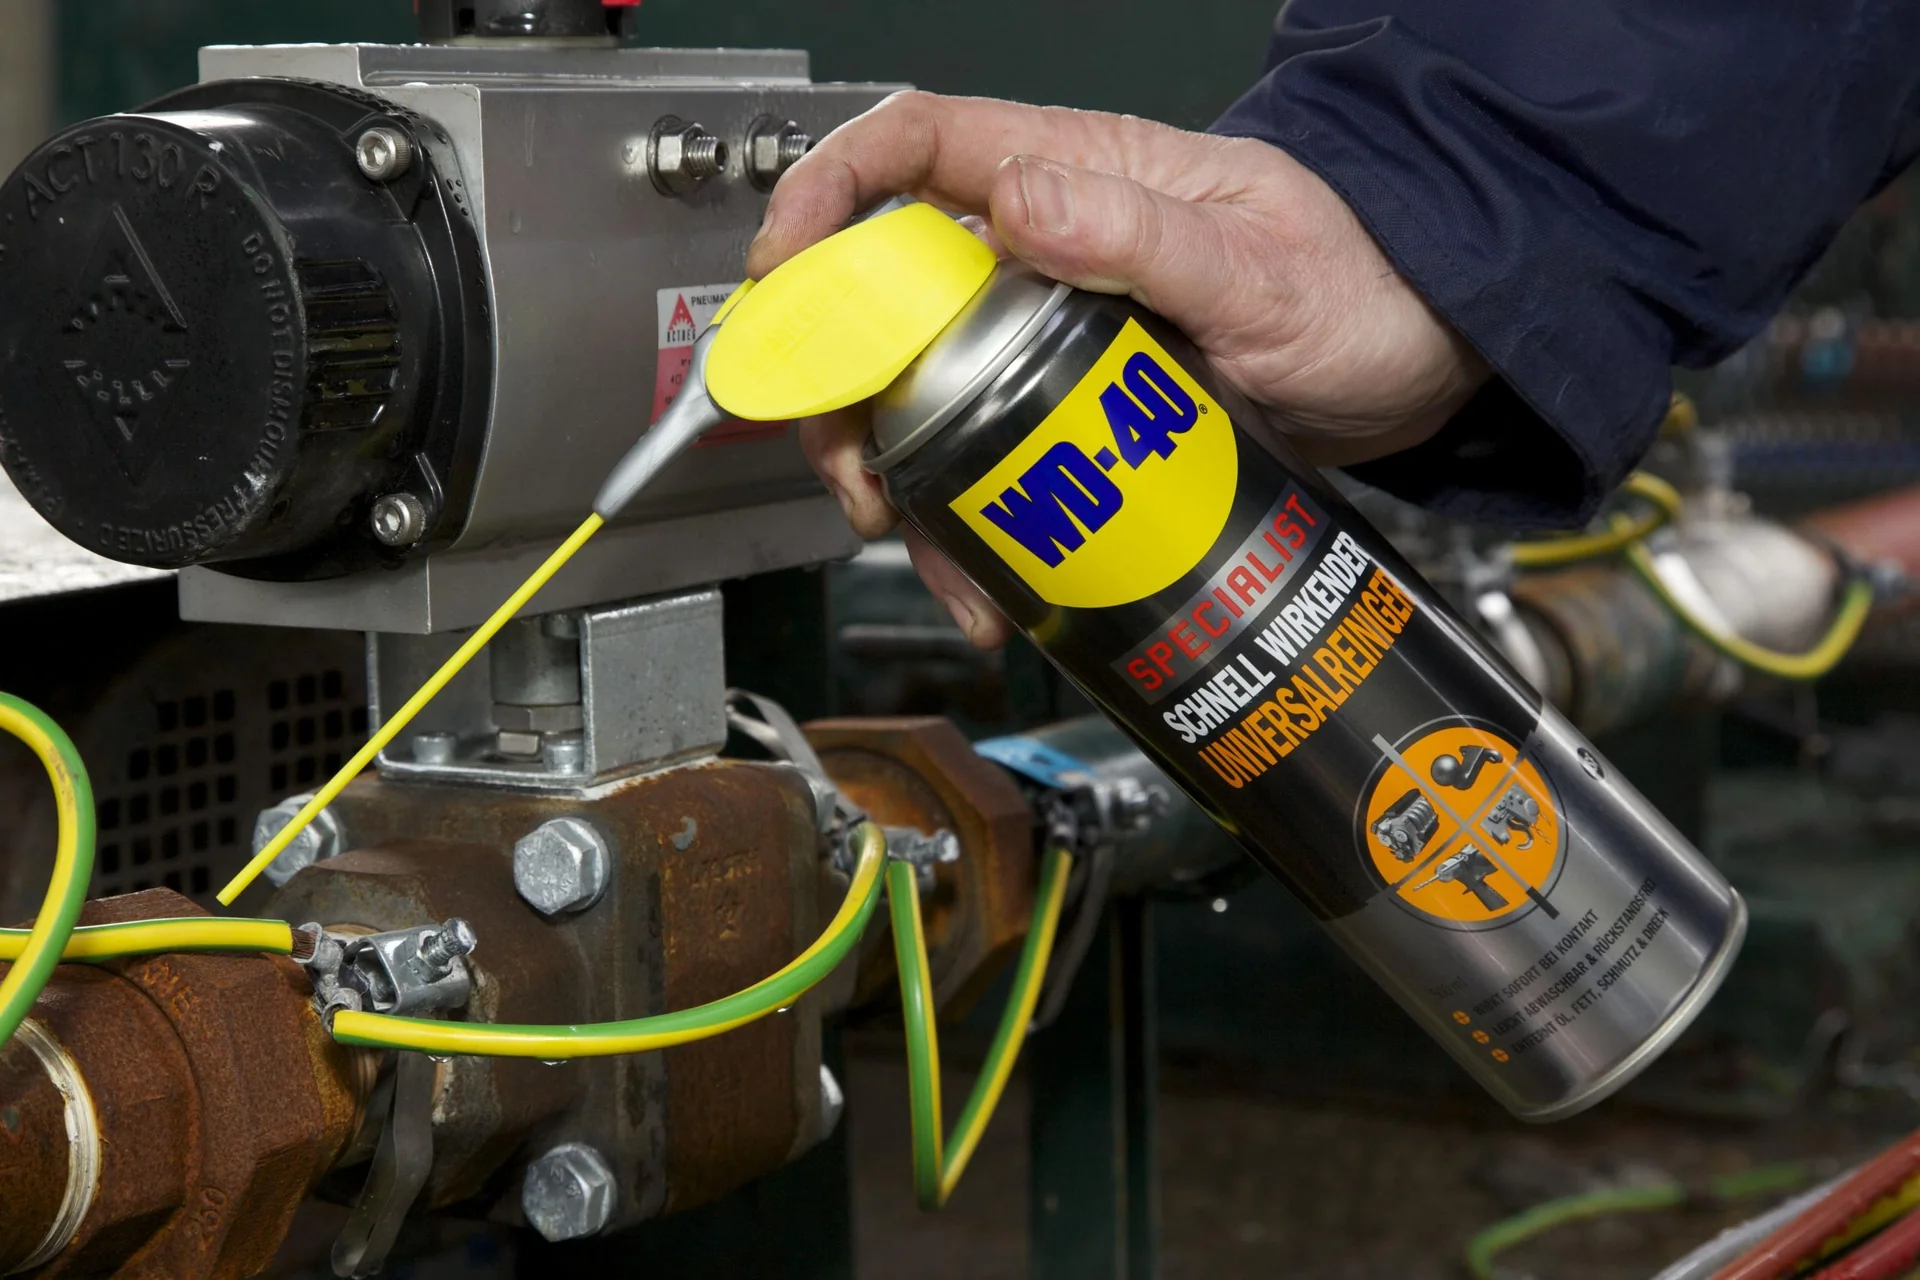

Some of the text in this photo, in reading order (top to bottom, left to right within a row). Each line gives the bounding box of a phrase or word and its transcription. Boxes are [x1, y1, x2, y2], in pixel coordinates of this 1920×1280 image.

[23, 134, 95, 220] ACT
[108, 131, 186, 188] 130
[979, 351, 1199, 569] WD-40
[1128, 494, 1317, 691] SPECIALIST
[1162, 530, 1372, 744] SCHNELL WIRKENDER
[1198, 566, 1417, 789] UNIVERSALREINIGER
[1502, 965, 1542, 998] SOFORT
[1538, 952, 1560, 972] BEI
[1555, 908, 1600, 955] KONTAKT
[1523, 961, 1590, 1018] ABWASCHBAR
[1586, 953, 1598, 966] &
[1595, 877, 1658, 958] RÜCKSTANDSFREI
[1639, 936, 1650, 951] &
[1641, 905, 1671, 943] DRECK
[1571, 988, 1604, 1016] FETT,
[1596, 946, 1643, 992] SCHMUTZ
[1553, 1007, 1576, 1028] ÖL,
